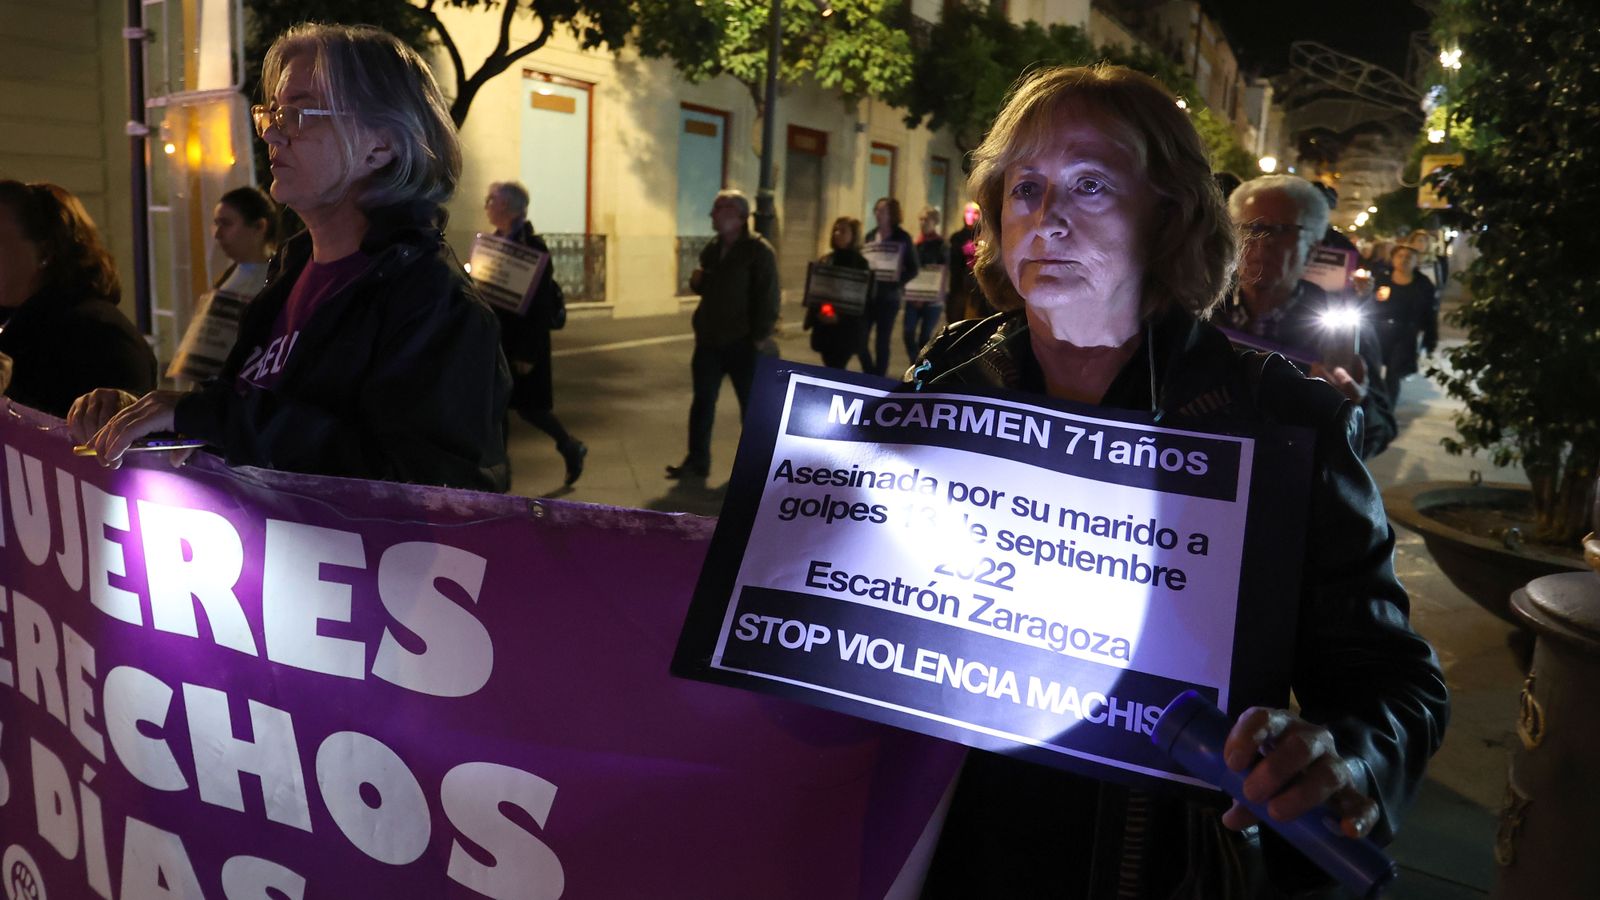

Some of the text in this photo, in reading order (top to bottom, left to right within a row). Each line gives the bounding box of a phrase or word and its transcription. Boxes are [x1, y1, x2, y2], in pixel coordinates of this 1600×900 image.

[827, 394, 1210, 477] M.CARMEN 71años
[772, 458, 1210, 556] Asesinada por su marido a
[778, 494, 889, 526] golpes
[996, 527, 1188, 592] septiembre
[0, 442, 495, 698] UJERES
[804, 559, 1131, 662] Escatrón Zaragoza
[734, 612, 1166, 738] STOP VIOLENCIA MACHIS
[0, 585, 566, 900] ERECHOS
